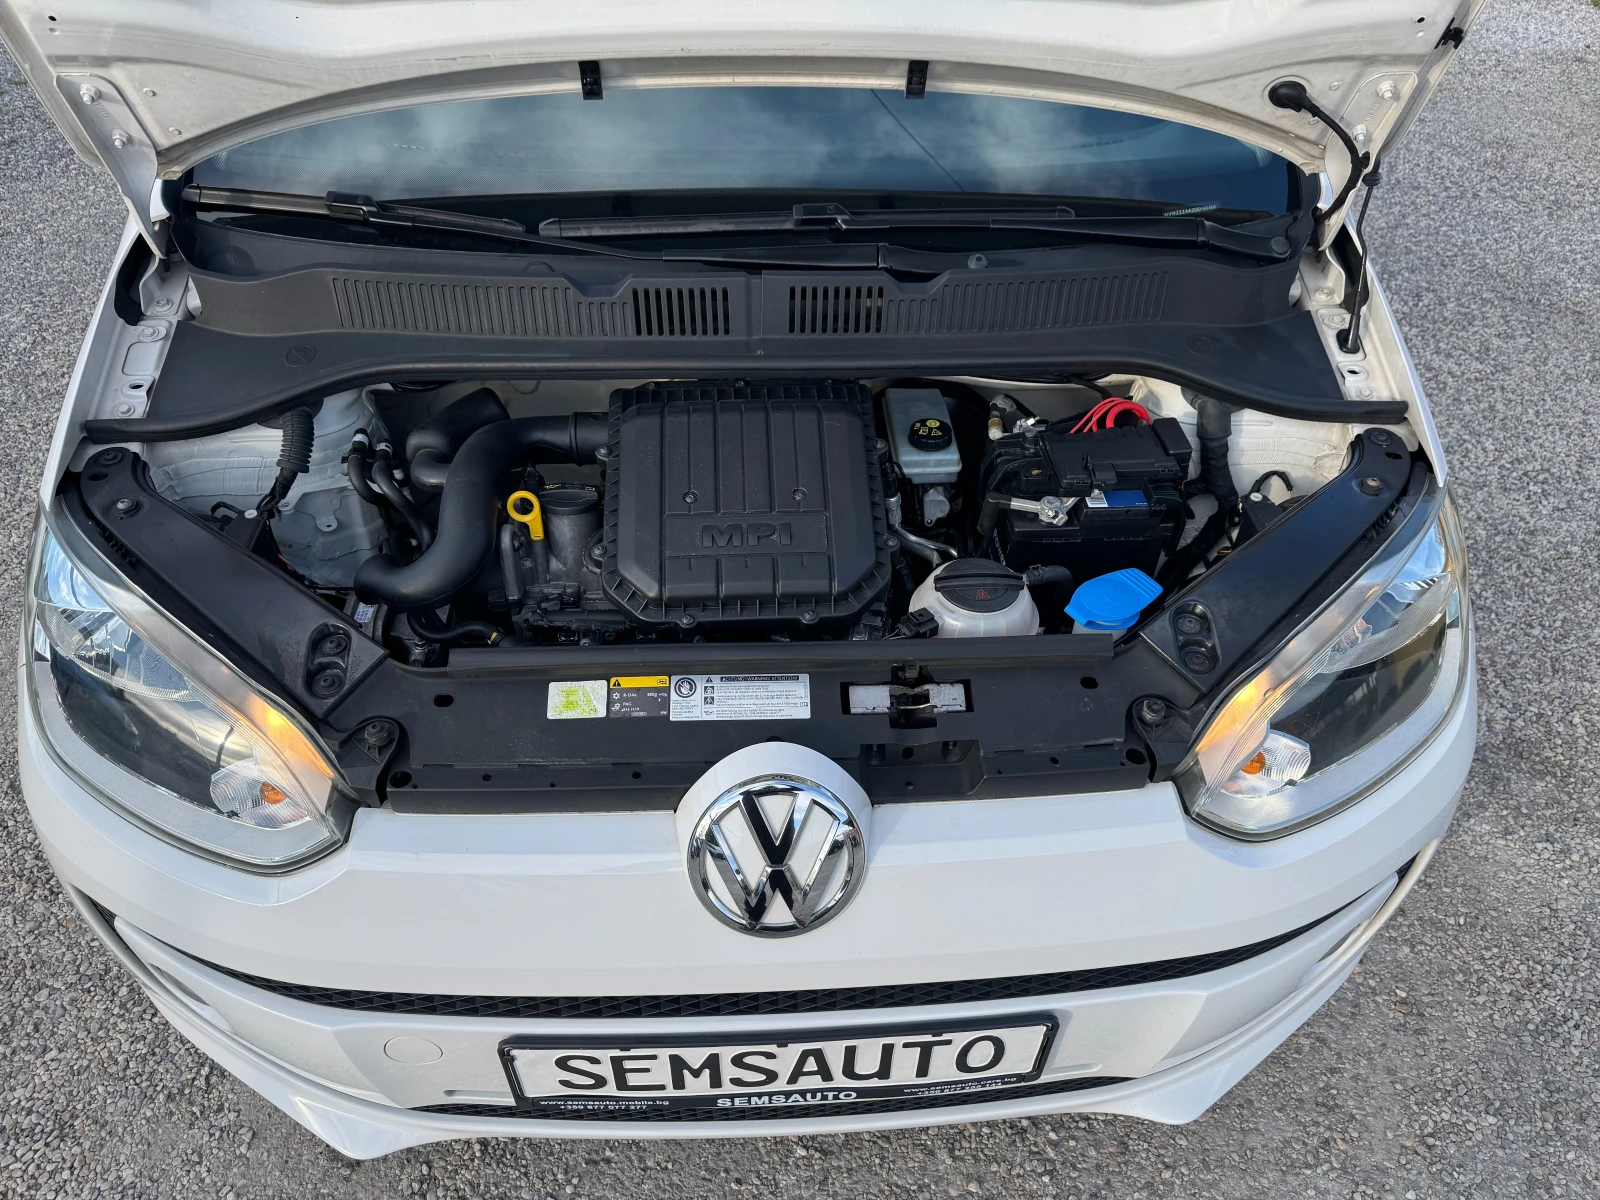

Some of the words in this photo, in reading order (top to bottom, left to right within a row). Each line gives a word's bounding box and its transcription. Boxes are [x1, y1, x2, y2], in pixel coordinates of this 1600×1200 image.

[701, 522, 792, 548] MPI
[553, 1034, 1008, 1092] SEMSAUTO
[716, 1091, 858, 1107] SEMSAUTO
